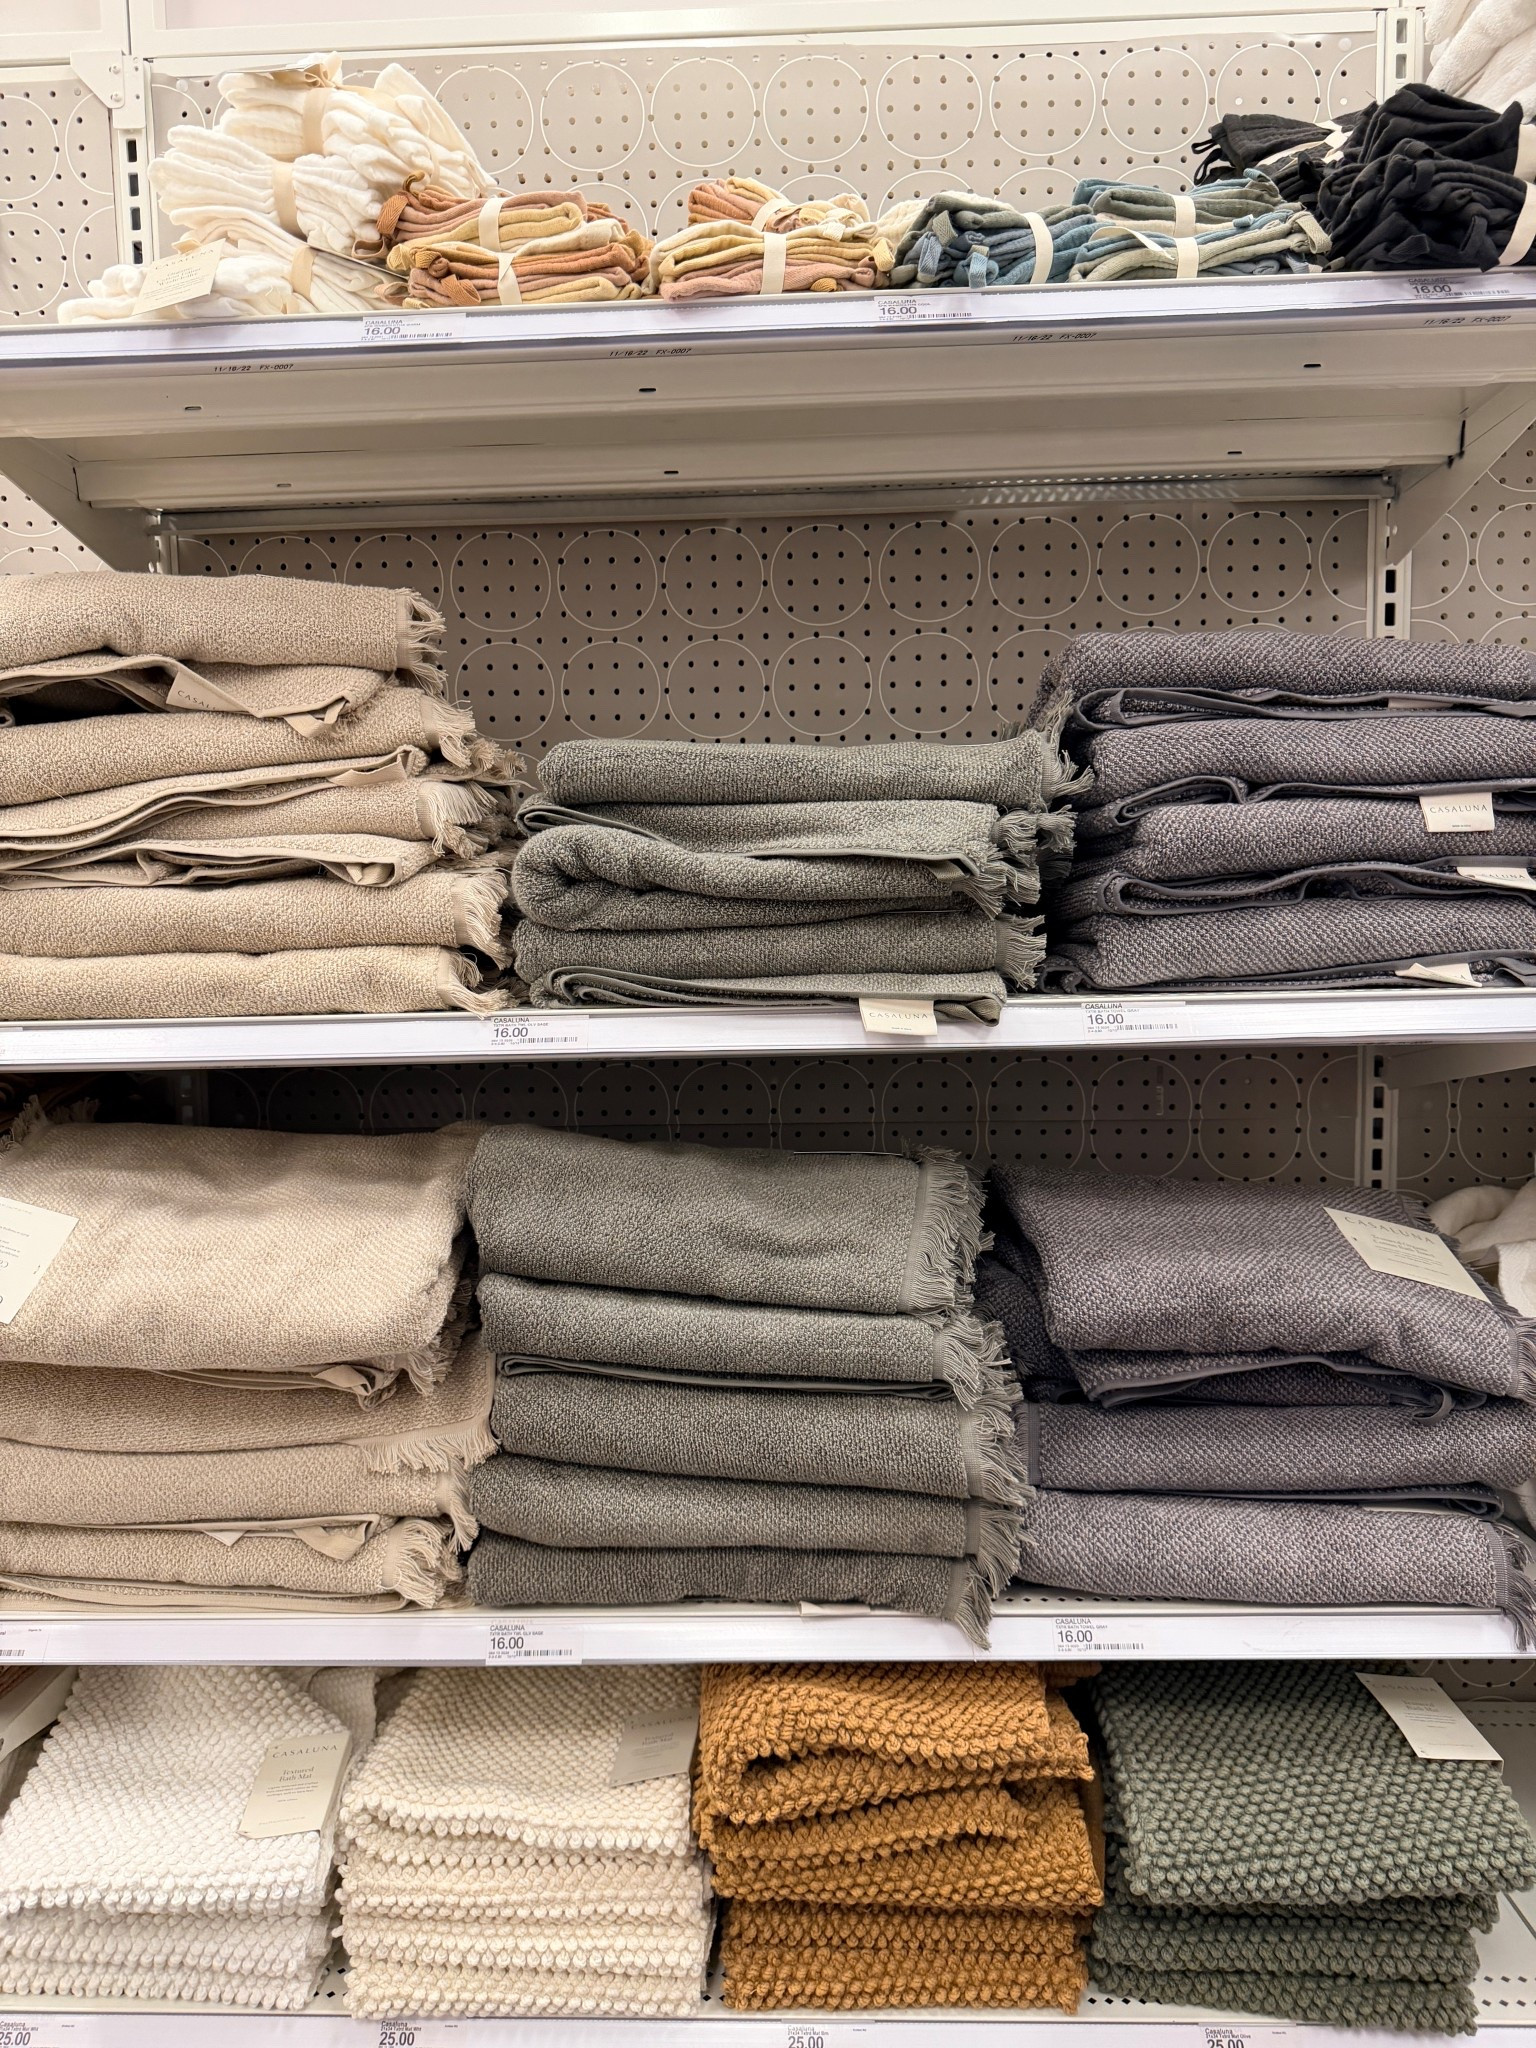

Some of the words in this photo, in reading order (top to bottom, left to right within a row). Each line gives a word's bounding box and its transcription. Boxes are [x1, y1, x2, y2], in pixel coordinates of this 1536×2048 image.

[1413, 285, 1452, 294] 16.00
[879, 306, 917, 315] 16.00
[364, 327, 401, 335] 16.00
[1429, 804, 1488, 813] CASALUNA
[1087, 1013, 1124, 1025] 16.00
[493, 1027, 529, 1038] 16.00
[1344, 1216, 1435, 1244] CASALUNA
[1057, 1630, 1093, 1643] 16.00
[490, 1636, 524, 1650] 16.00
[272, 1744, 338, 1758] CASALUNA
[283, 1766, 315, 1775] Textured
[381, 2020, 408, 2028] Casaluna
[379, 2031, 415, 2046] 25.00
